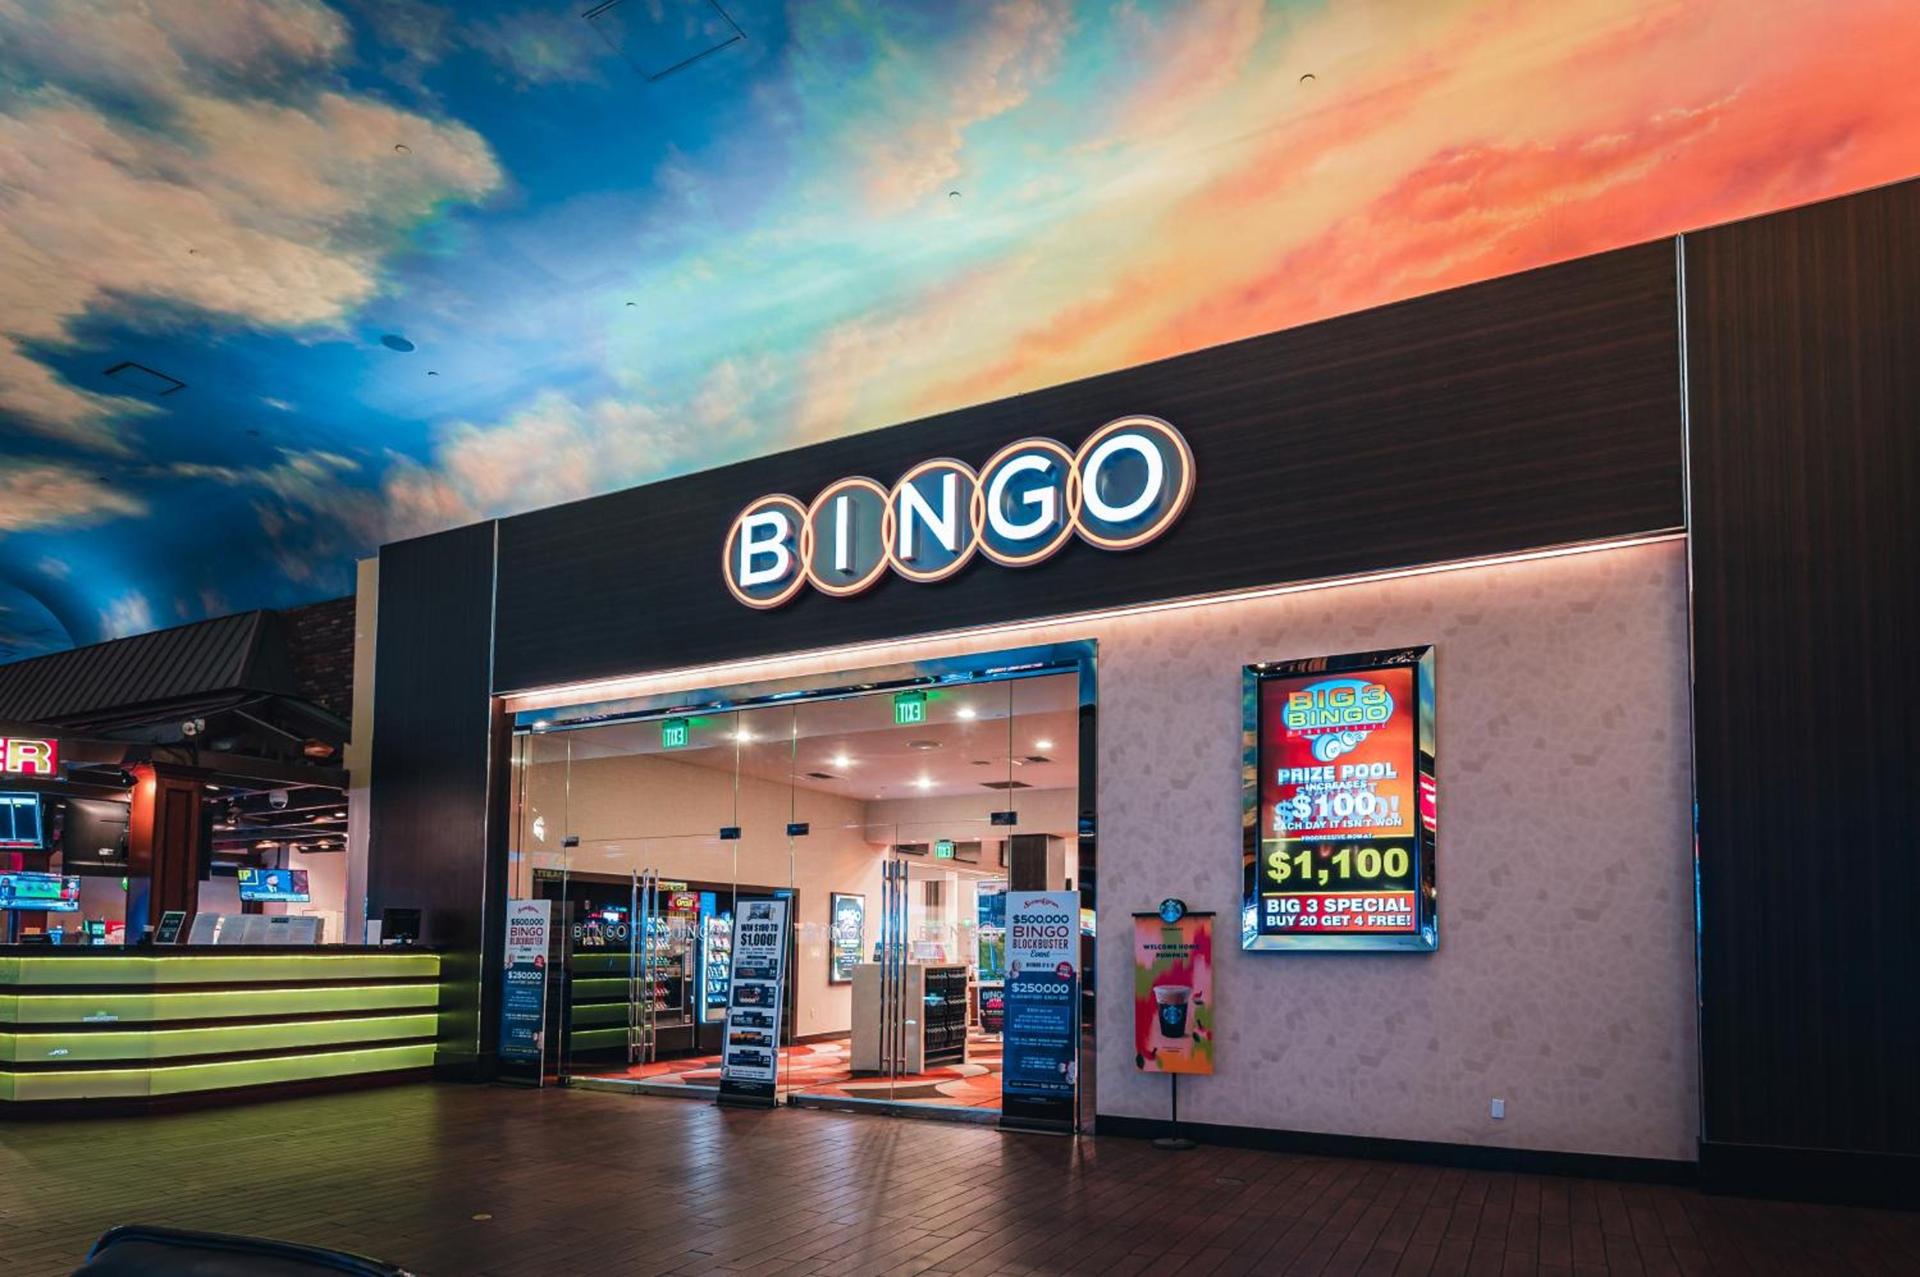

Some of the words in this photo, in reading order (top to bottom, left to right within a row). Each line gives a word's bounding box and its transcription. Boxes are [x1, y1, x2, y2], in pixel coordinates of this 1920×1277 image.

[740, 434, 1163, 586] BINGO
[1288, 687, 1356, 711] BIG
[1361, 684, 1387, 705] 3
[1287, 705, 1388, 727] BINGO
[0, 739, 52, 773] R
[1278, 766, 1335, 785] PRIZE
[1341, 763, 1398, 780] POOL
[1305, 780, 1368, 792] INCREASES
[1292, 791, 1377, 819] $100
[1273, 820, 1302, 831] EACH
[1305, 821, 1327, 830] DAY
[1329, 820, 1340, 829] IT
[1344, 819, 1371, 828] ISN'T
[1375, 817, 1403, 827] WON
[1267, 848, 1409, 886] $1,100
[1267, 899, 1300, 913] BIG
[1306, 898, 1318, 912] 3
[1324, 898, 1411, 913] SPECIAL
[1267, 915, 1296, 926] BUY
[1300, 915, 1317, 926] 20
[1321, 915, 1350, 926] GET
[1354, 915, 1363, 926] 4
[1368, 914, 1411, 926] FREE!
[510, 927, 544, 936] BINGO
[574, 925, 627, 938] BINGO
[1013, 926, 1069, 938] BINGO
[740, 933, 777, 947] $1,000!
[1013, 939, 1069, 949] BLOCKBUSTER
